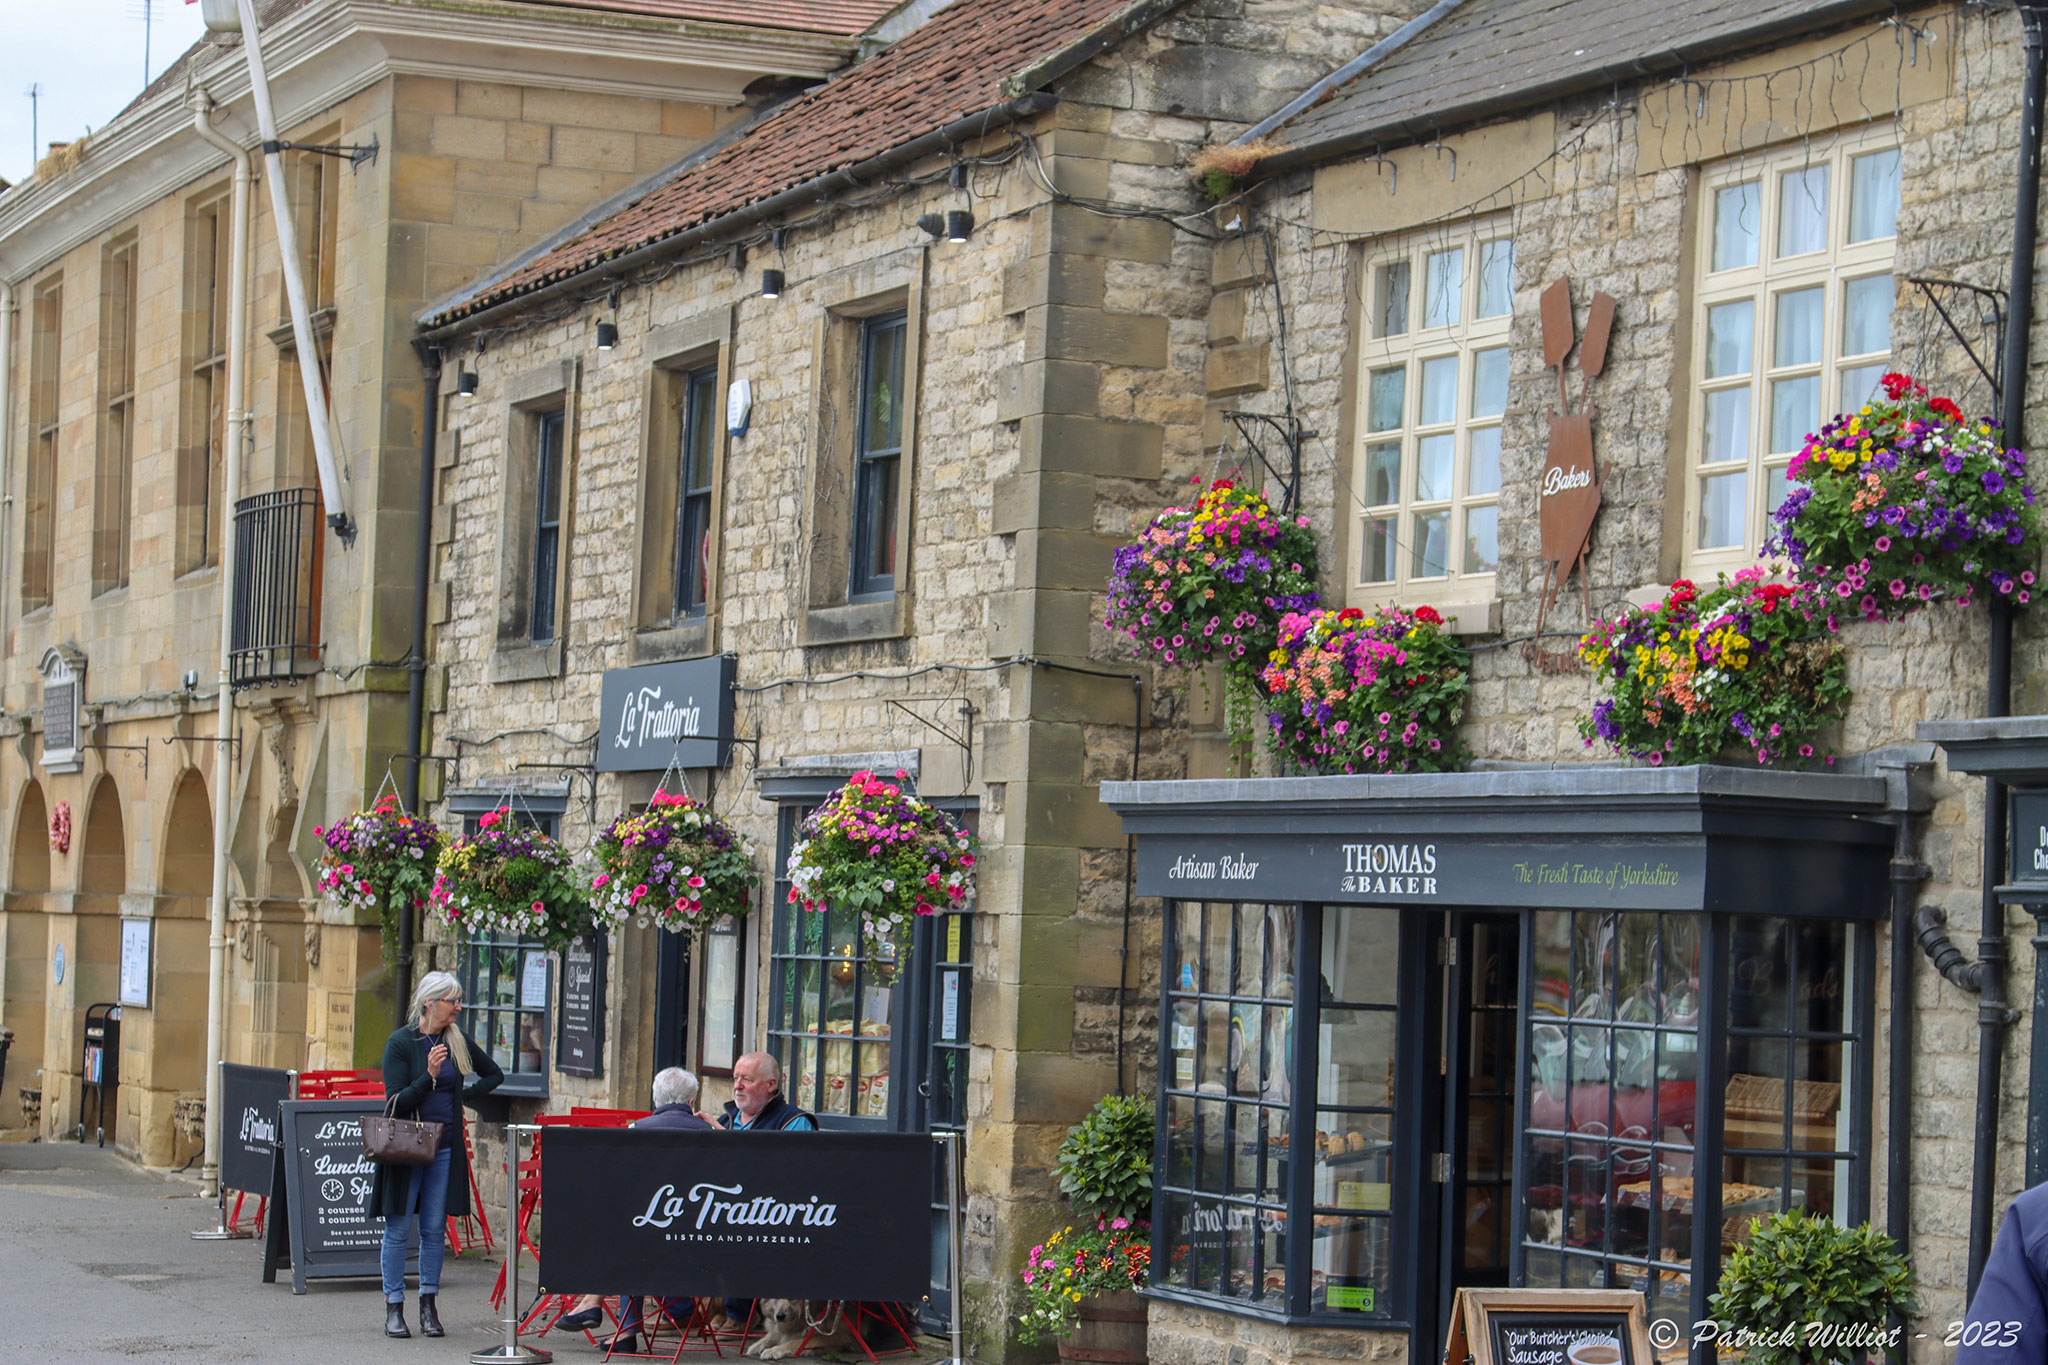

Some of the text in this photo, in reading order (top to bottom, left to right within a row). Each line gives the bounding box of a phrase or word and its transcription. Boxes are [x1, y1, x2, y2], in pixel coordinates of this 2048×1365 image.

[1543, 465, 1591, 497] Bakers
[615, 685, 700, 748] La Trattoria
[1169, 853, 1259, 880] Artisan Baker
[1342, 844, 1437, 874] THOMAS
[1341, 876, 1437, 894] The BAKER
[1512, 861, 1680, 890] The Fresh Taste of Yorkshire
[315, 1122, 336, 1139] La
[632, 1183, 837, 1230] La Trattoria
[328, 1216, 365, 1224] courses
[666, 1234, 811, 1244] BISTRO AND PIZZERIA
[1530, 1329, 1576, 1346] Butcher's
[1507, 1347, 1563, 1365] Sausage
